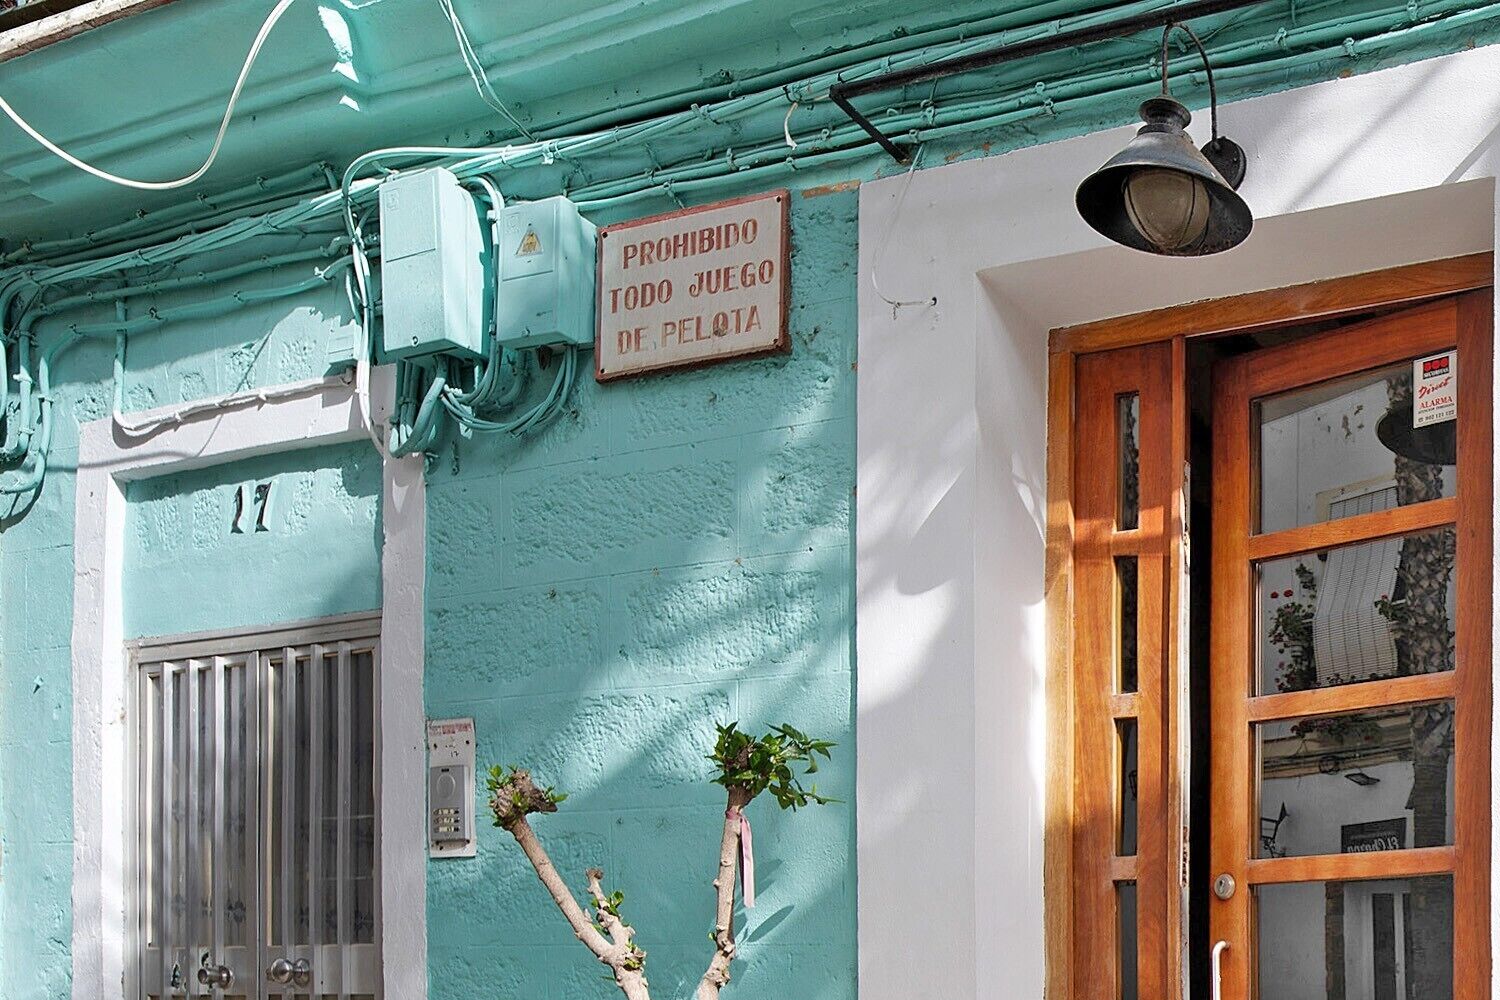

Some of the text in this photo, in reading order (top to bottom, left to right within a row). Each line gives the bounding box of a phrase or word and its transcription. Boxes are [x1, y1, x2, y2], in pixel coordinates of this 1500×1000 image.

[623, 218, 758, 270] PROHIBIDO
[609, 259, 775, 314] TODO JUEGO
[617, 305, 762, 355] DE PELOTA
[1419, 396, 1453, 409] ALARMA
[230, 481, 270, 534] 17
